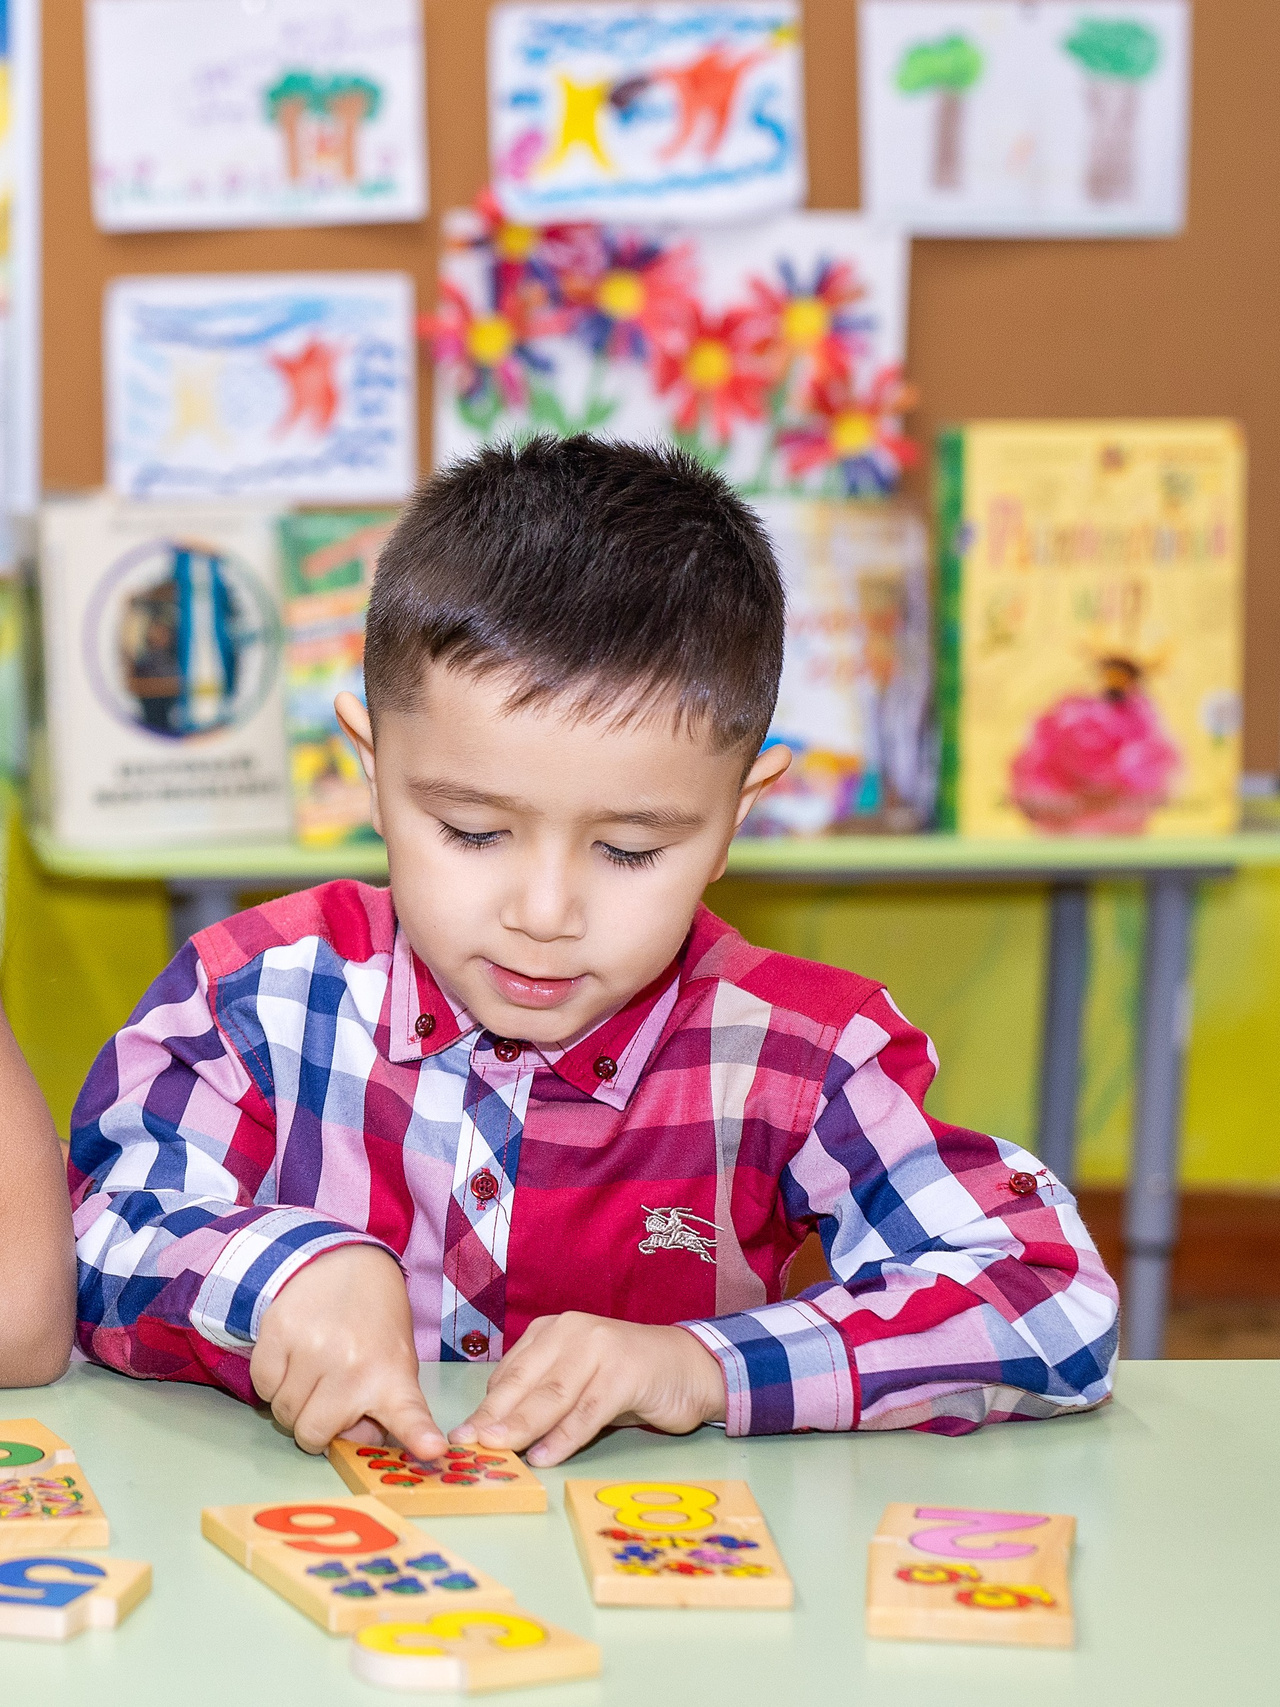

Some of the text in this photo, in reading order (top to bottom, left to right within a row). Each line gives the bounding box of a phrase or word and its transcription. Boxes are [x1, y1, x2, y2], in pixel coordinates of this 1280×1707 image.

[595, 1481, 719, 1533] 8
[907, 1505, 1048, 1561] 2
[356, 1610, 549, 1658] 3
